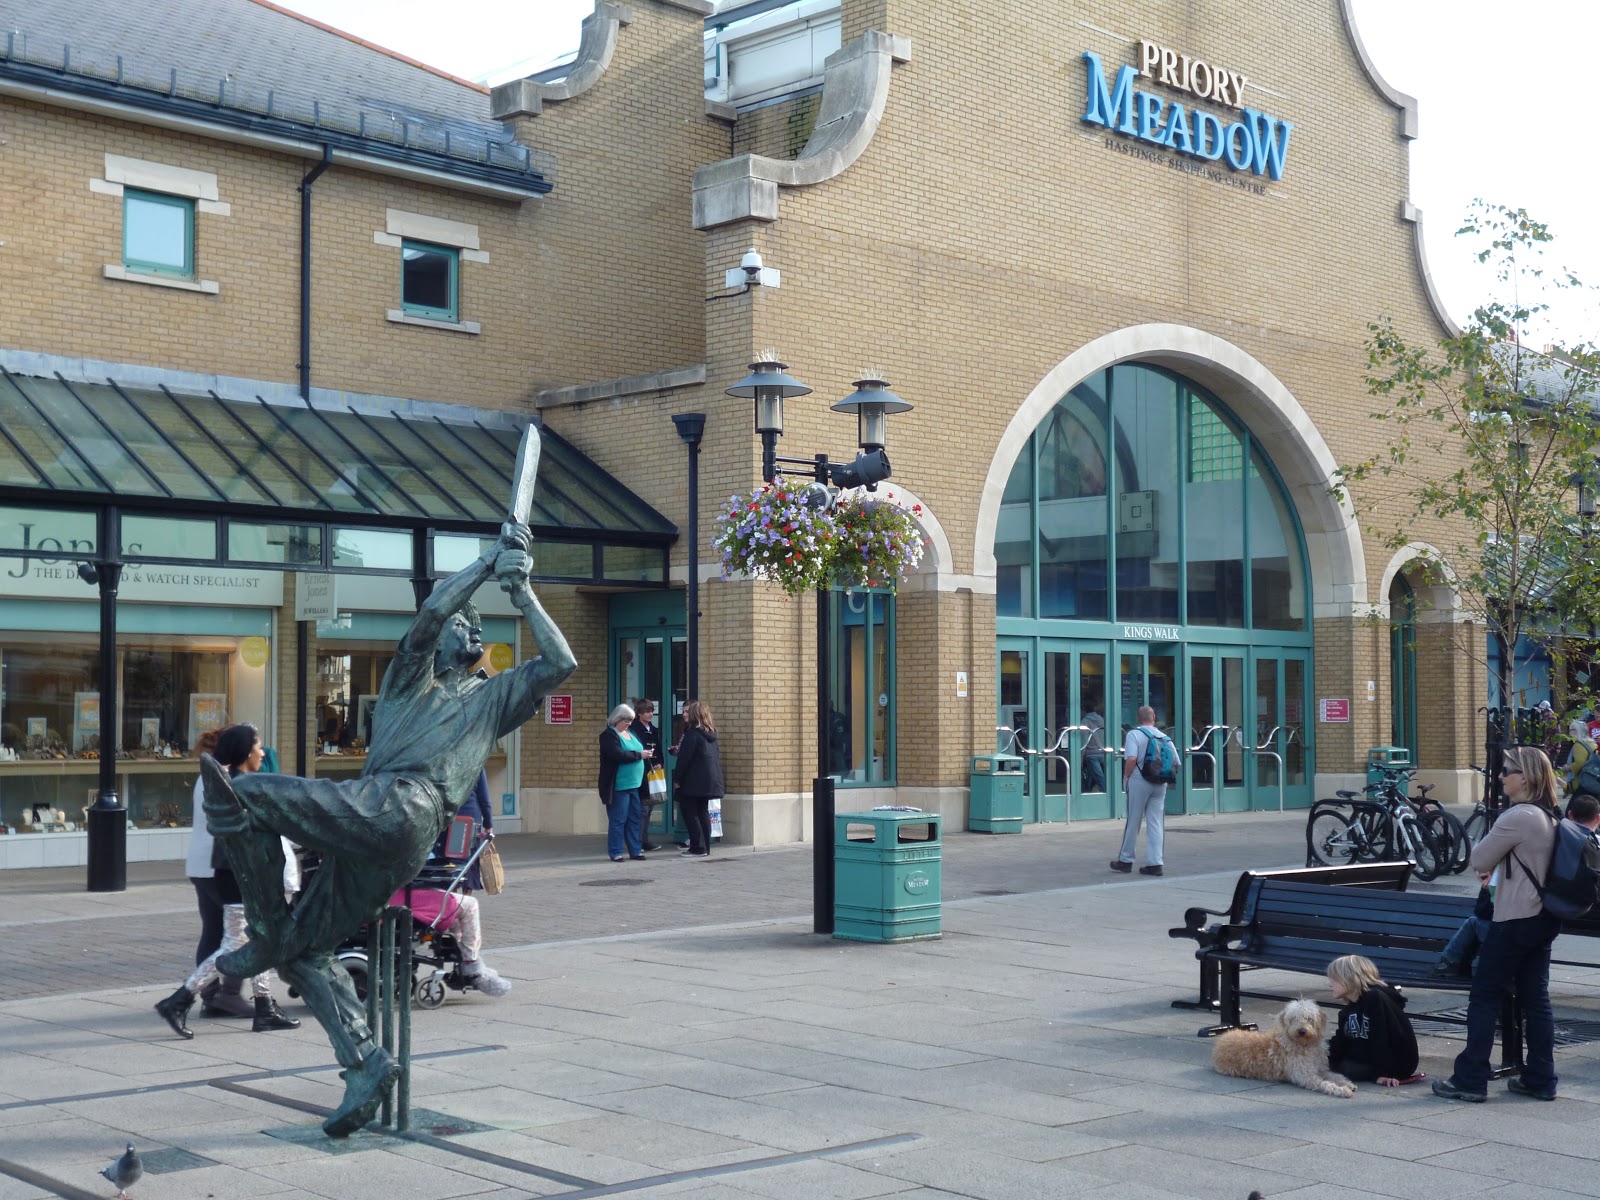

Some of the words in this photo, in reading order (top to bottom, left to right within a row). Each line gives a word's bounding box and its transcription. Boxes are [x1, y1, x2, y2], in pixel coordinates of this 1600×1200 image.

[1136, 39, 1248, 109] PRIORY
[1081, 51, 1294, 181] MEADOW
[1168, 158, 1222, 182] SHOPPING
[1225, 175, 1267, 196] CENTRE
[8, 522, 143, 579] Jons
[34, 567, 62, 579] THE
[133, 571, 142, 583] &
[146, 572, 189, 585] WATCH
[193, 575, 260, 588] SPECIALIST
[305, 586, 328, 602] Jones
[1124, 626, 1153, 639] KINGS
[1153, 627, 1180, 640] WALK
